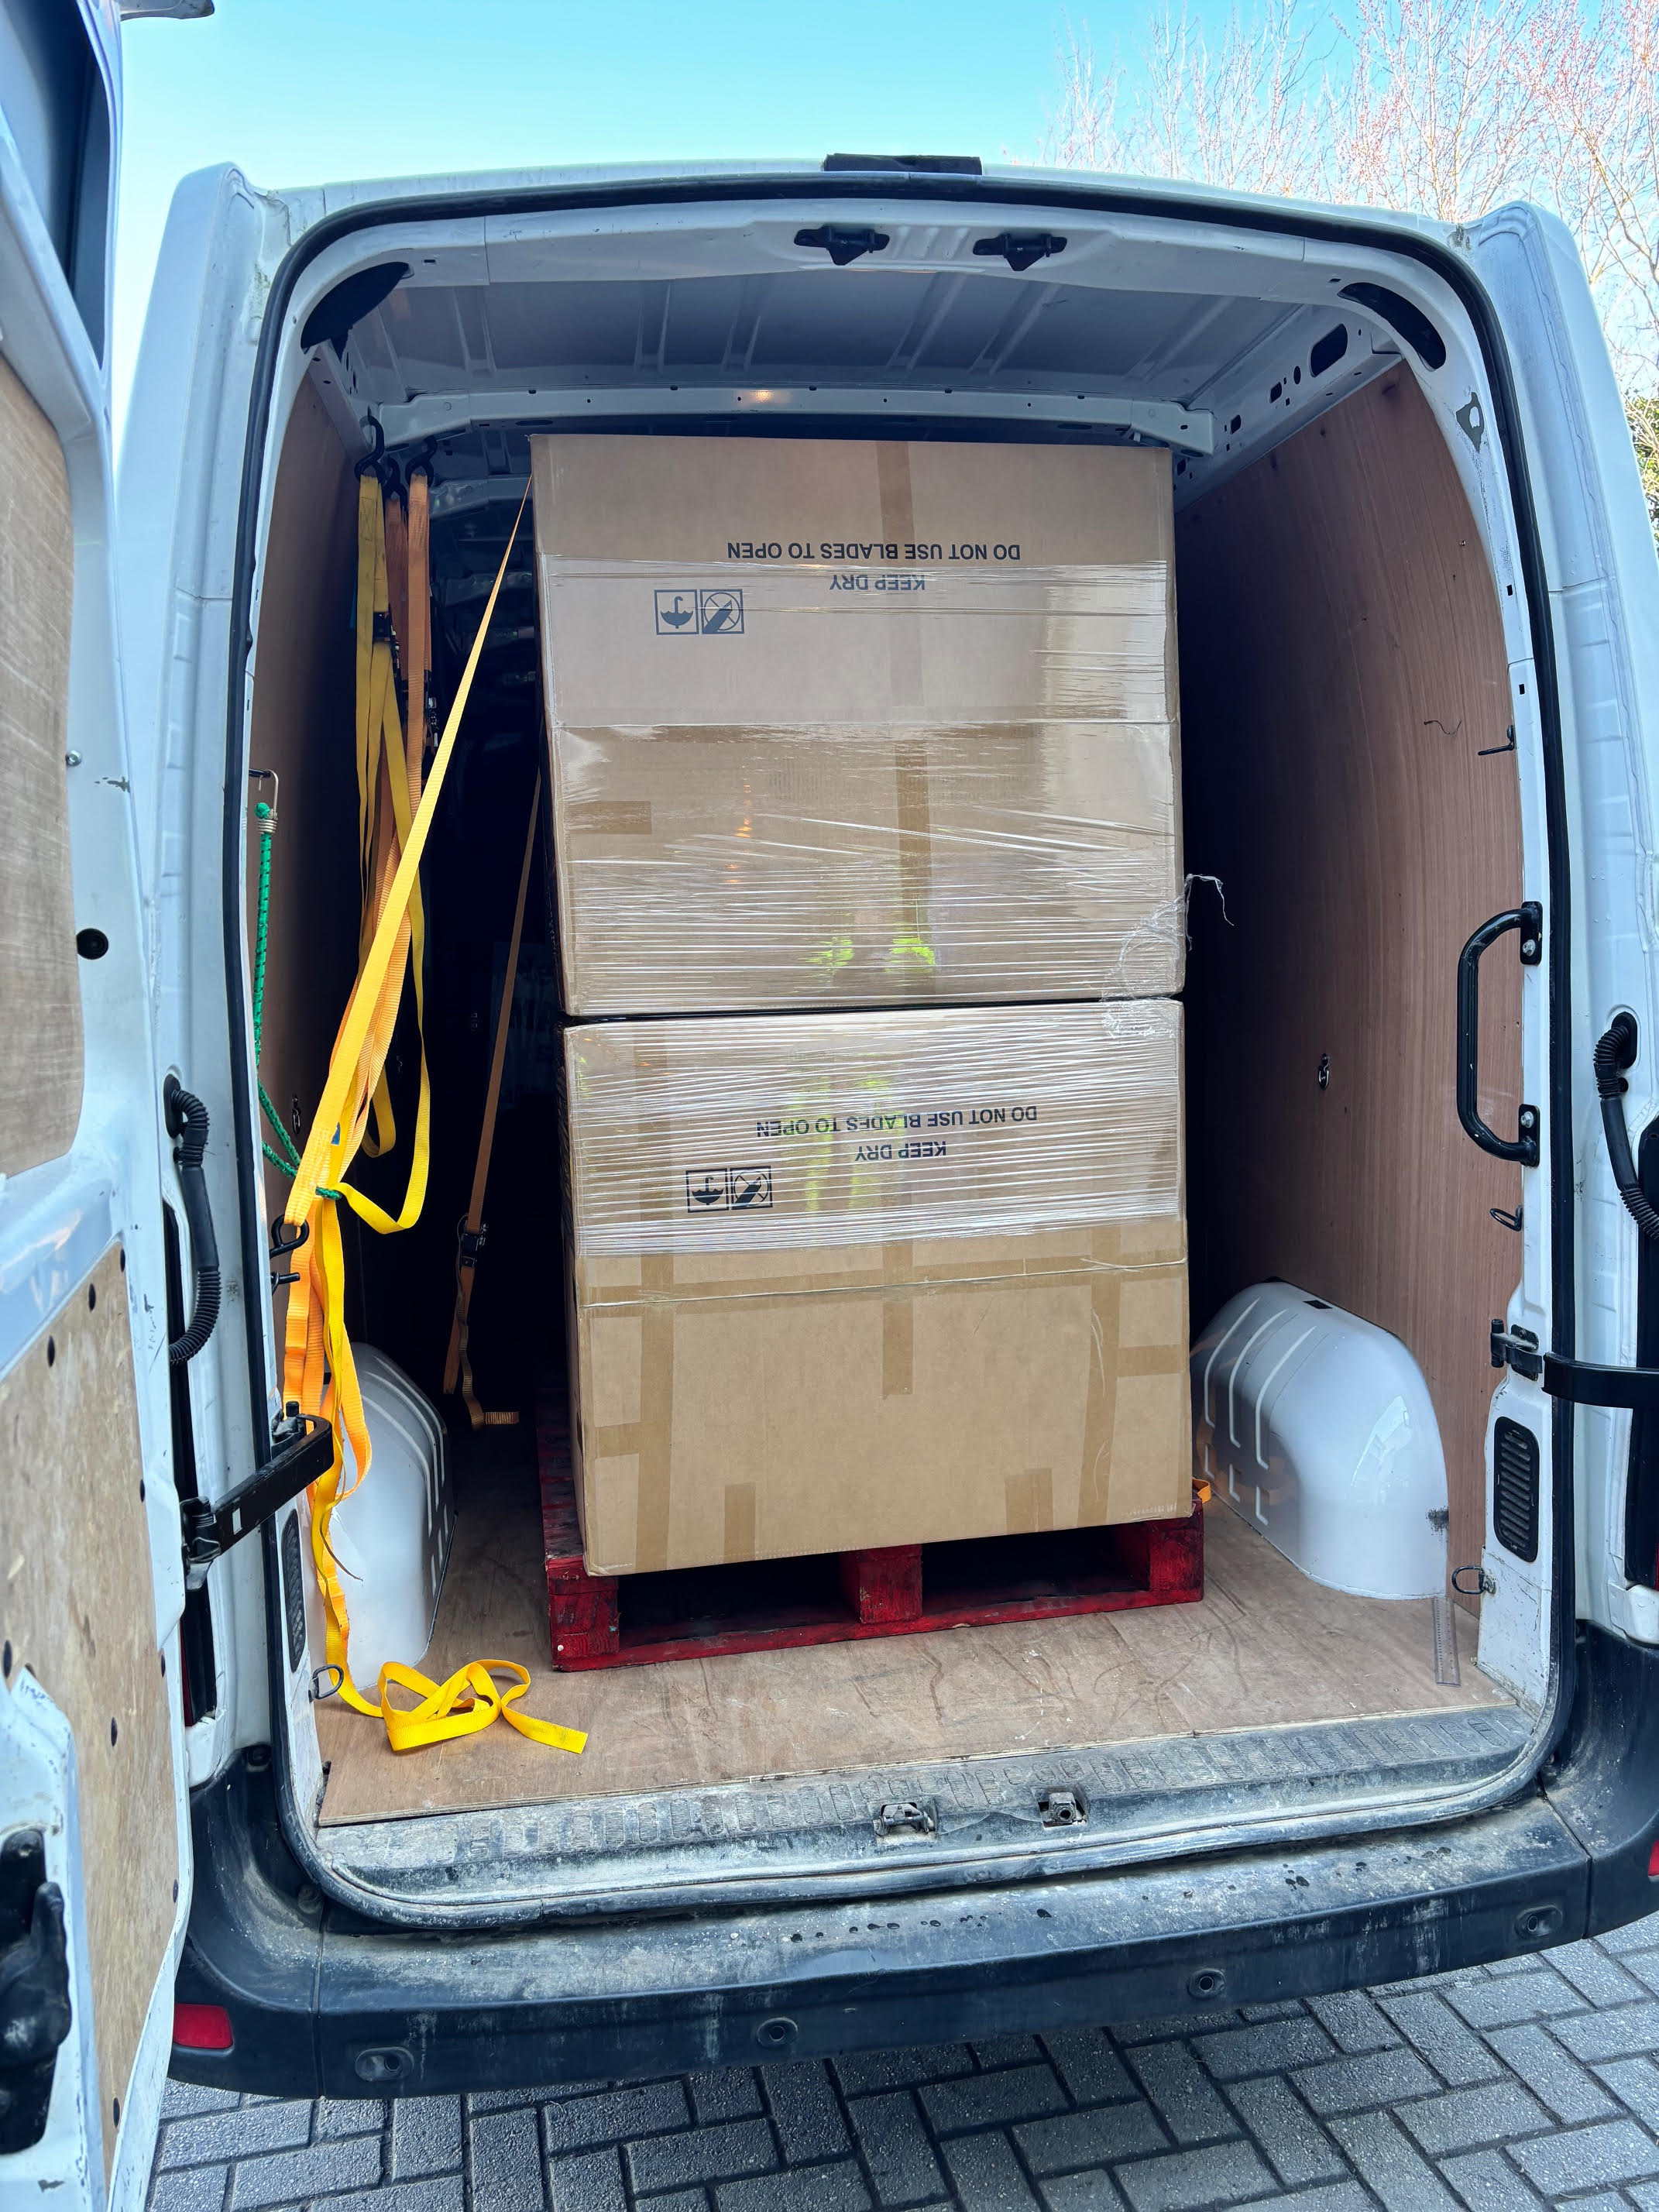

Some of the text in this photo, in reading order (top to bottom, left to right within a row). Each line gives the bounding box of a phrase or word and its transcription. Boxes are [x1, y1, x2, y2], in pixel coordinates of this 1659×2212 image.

[727, 542, 1021, 561] DO NOT USE BLADES TO OPEN
[829, 574, 926, 591] KEEP DRY
[756, 1105, 1037, 1137] DO NOT USE BLADES TO OPEN
[854, 1141, 946, 1162] KEEP DRY
